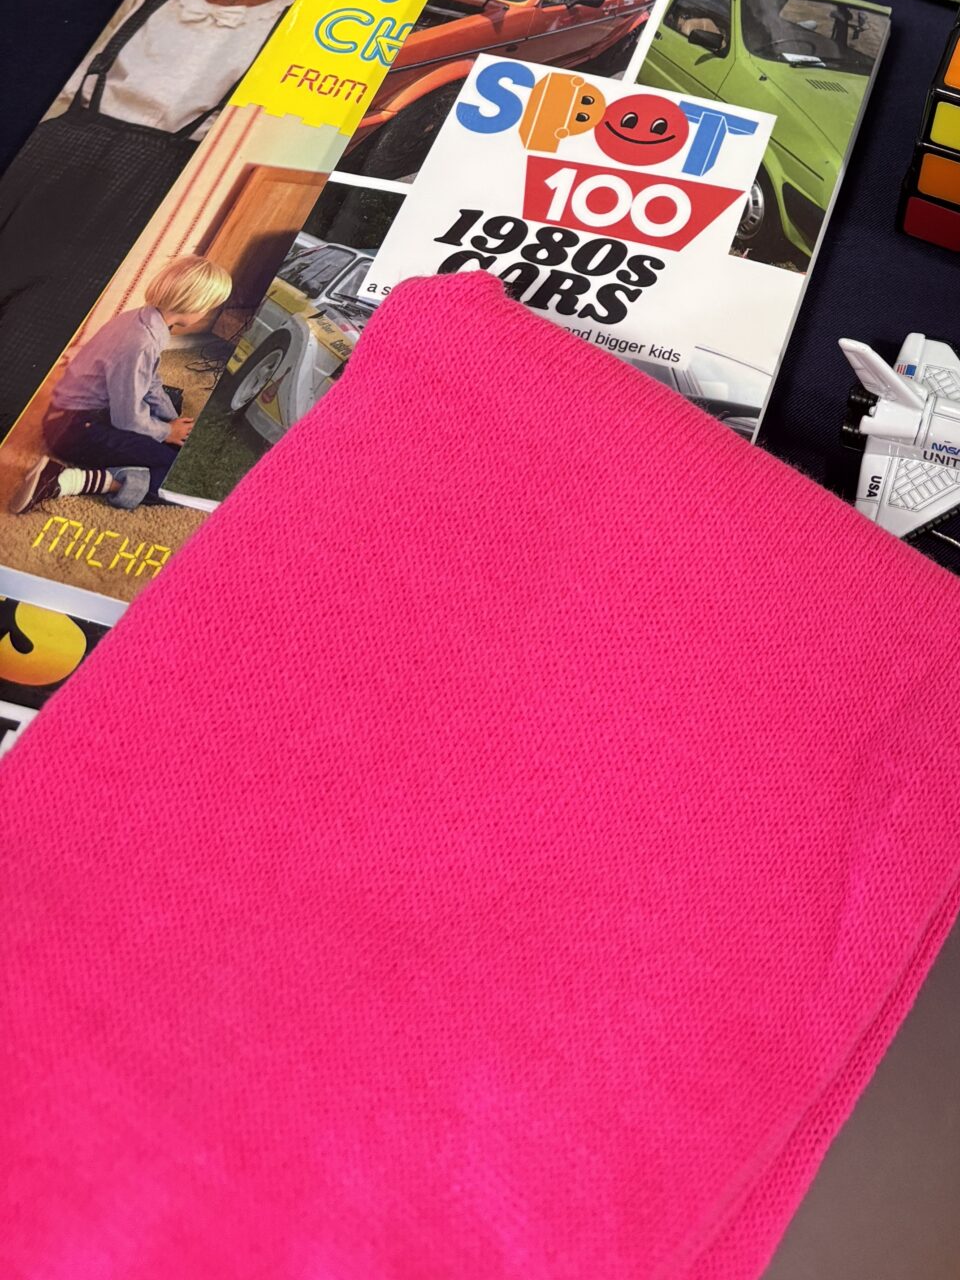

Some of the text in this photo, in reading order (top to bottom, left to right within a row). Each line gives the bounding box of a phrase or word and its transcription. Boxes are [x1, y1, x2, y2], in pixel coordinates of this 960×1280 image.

[280, 64, 368, 104] FROM
[456, 61, 760, 177] SPOT
[544, 167, 692, 237] 100
[433, 208, 666, 288] 1980s
[366, 282, 378, 294] a
[595, 331, 646, 355] bigger
[649, 344, 681, 363] kids
[866, 475, 882, 498] USA
